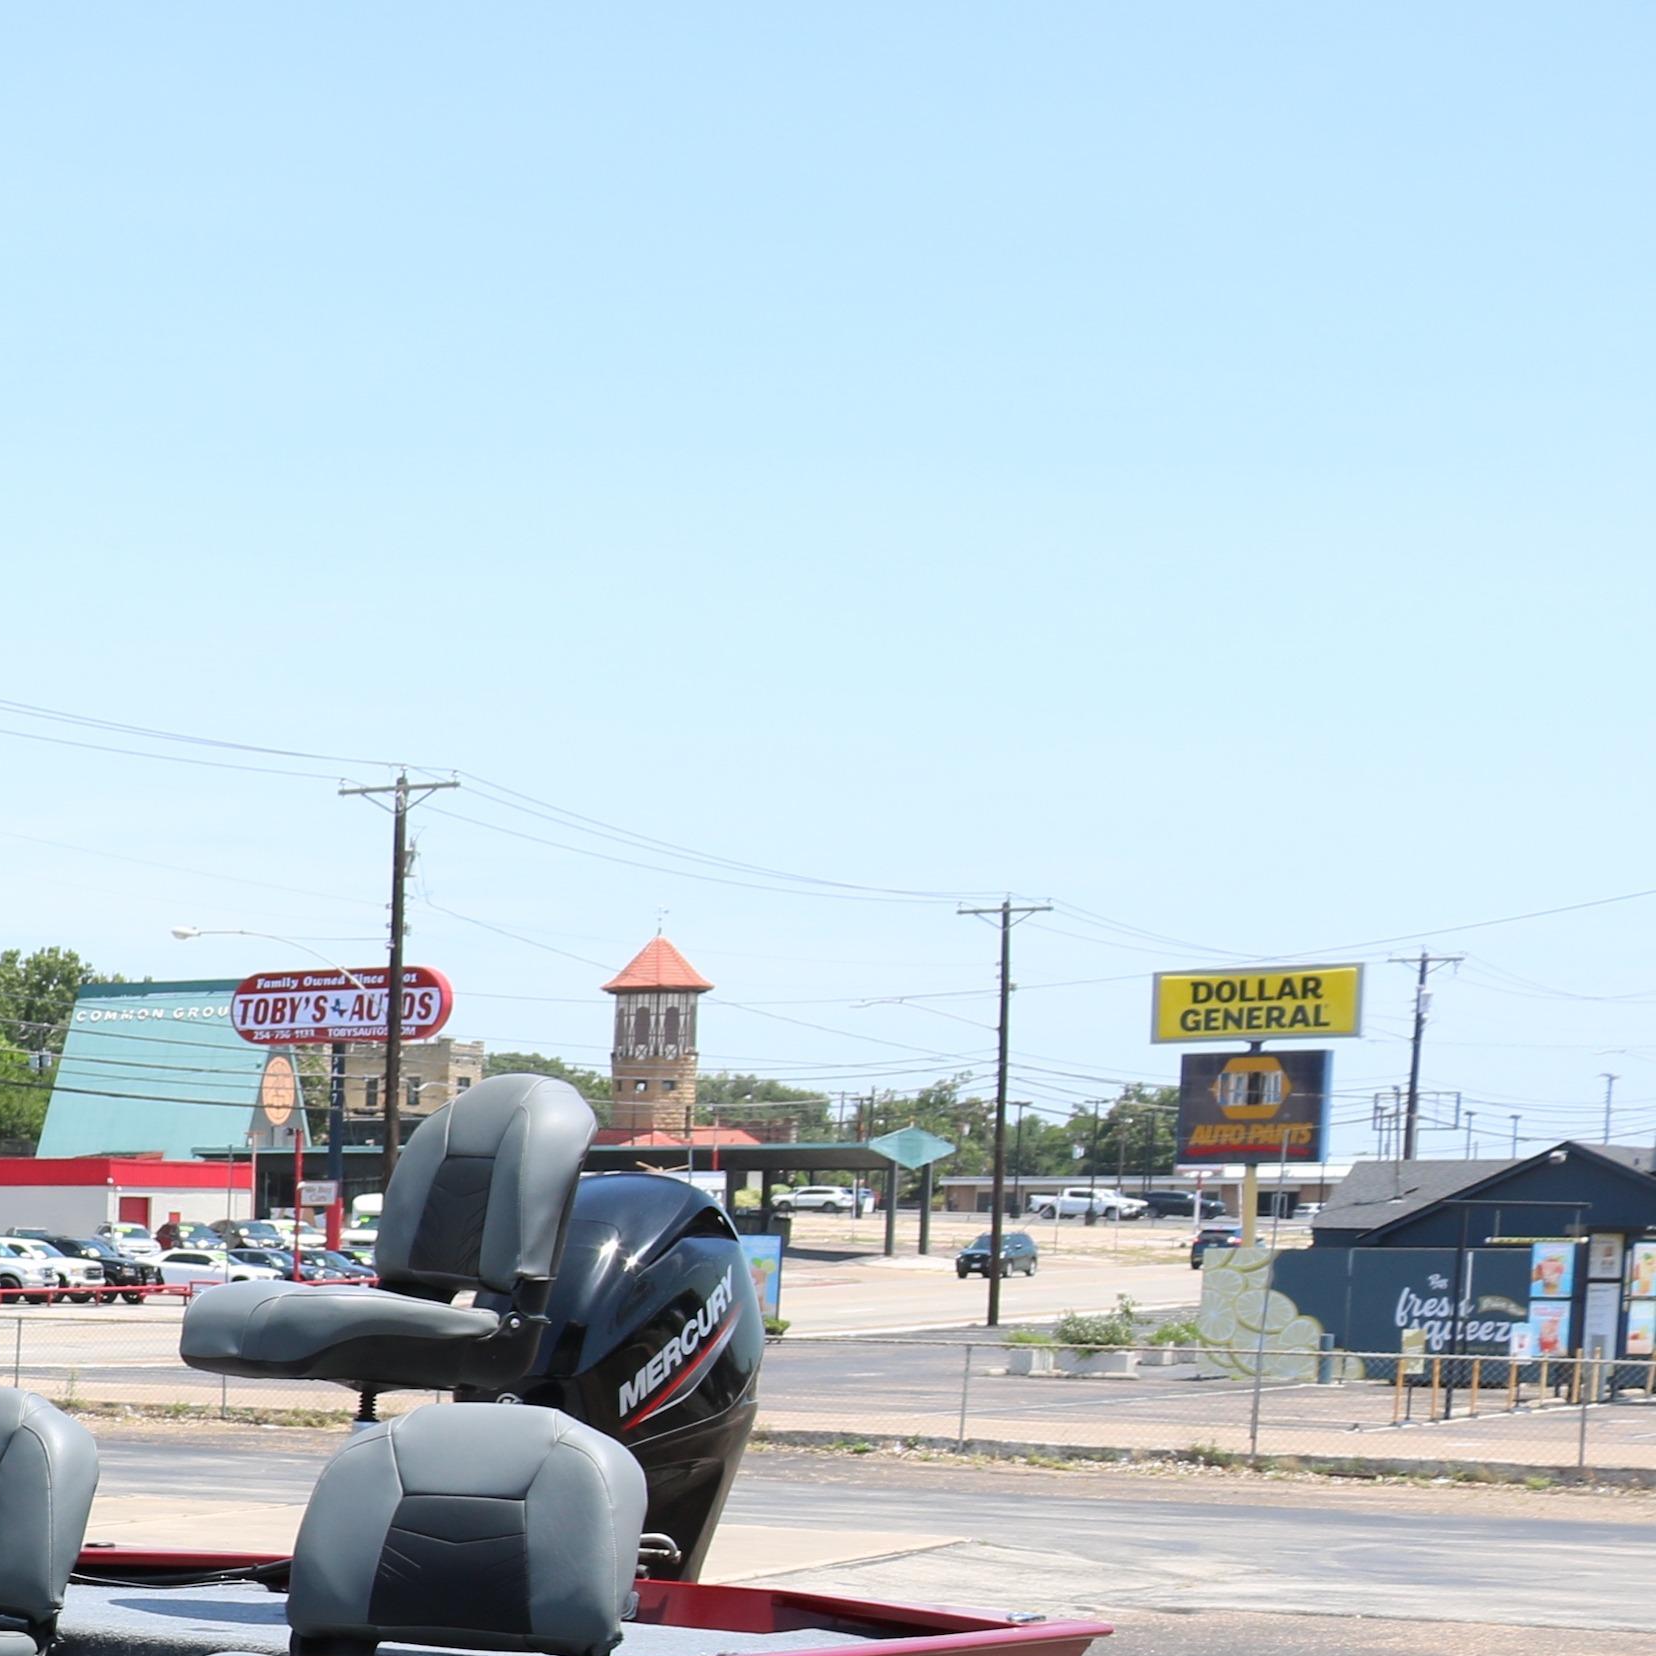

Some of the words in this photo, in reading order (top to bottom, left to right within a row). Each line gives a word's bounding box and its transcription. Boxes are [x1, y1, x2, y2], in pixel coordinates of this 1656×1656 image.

[256, 977, 298, 990] Family
[303, 975, 345, 986] Owned
[351, 973, 384, 986] Since
[1190, 977, 1323, 1004] DOLLAR
[76, 1008, 165, 1022] COMMON
[173, 1006, 229, 1020] GROU
[239, 995, 328, 1025] TOBY'S
[349, 991, 433, 1022] AUOS
[1179, 1004, 1331, 1032] GENERAL
[1189, 1124, 1244, 1146] AUTO
[1246, 1122, 1313, 1145] PARTS
[619, 1264, 733, 1418] MERCURY
